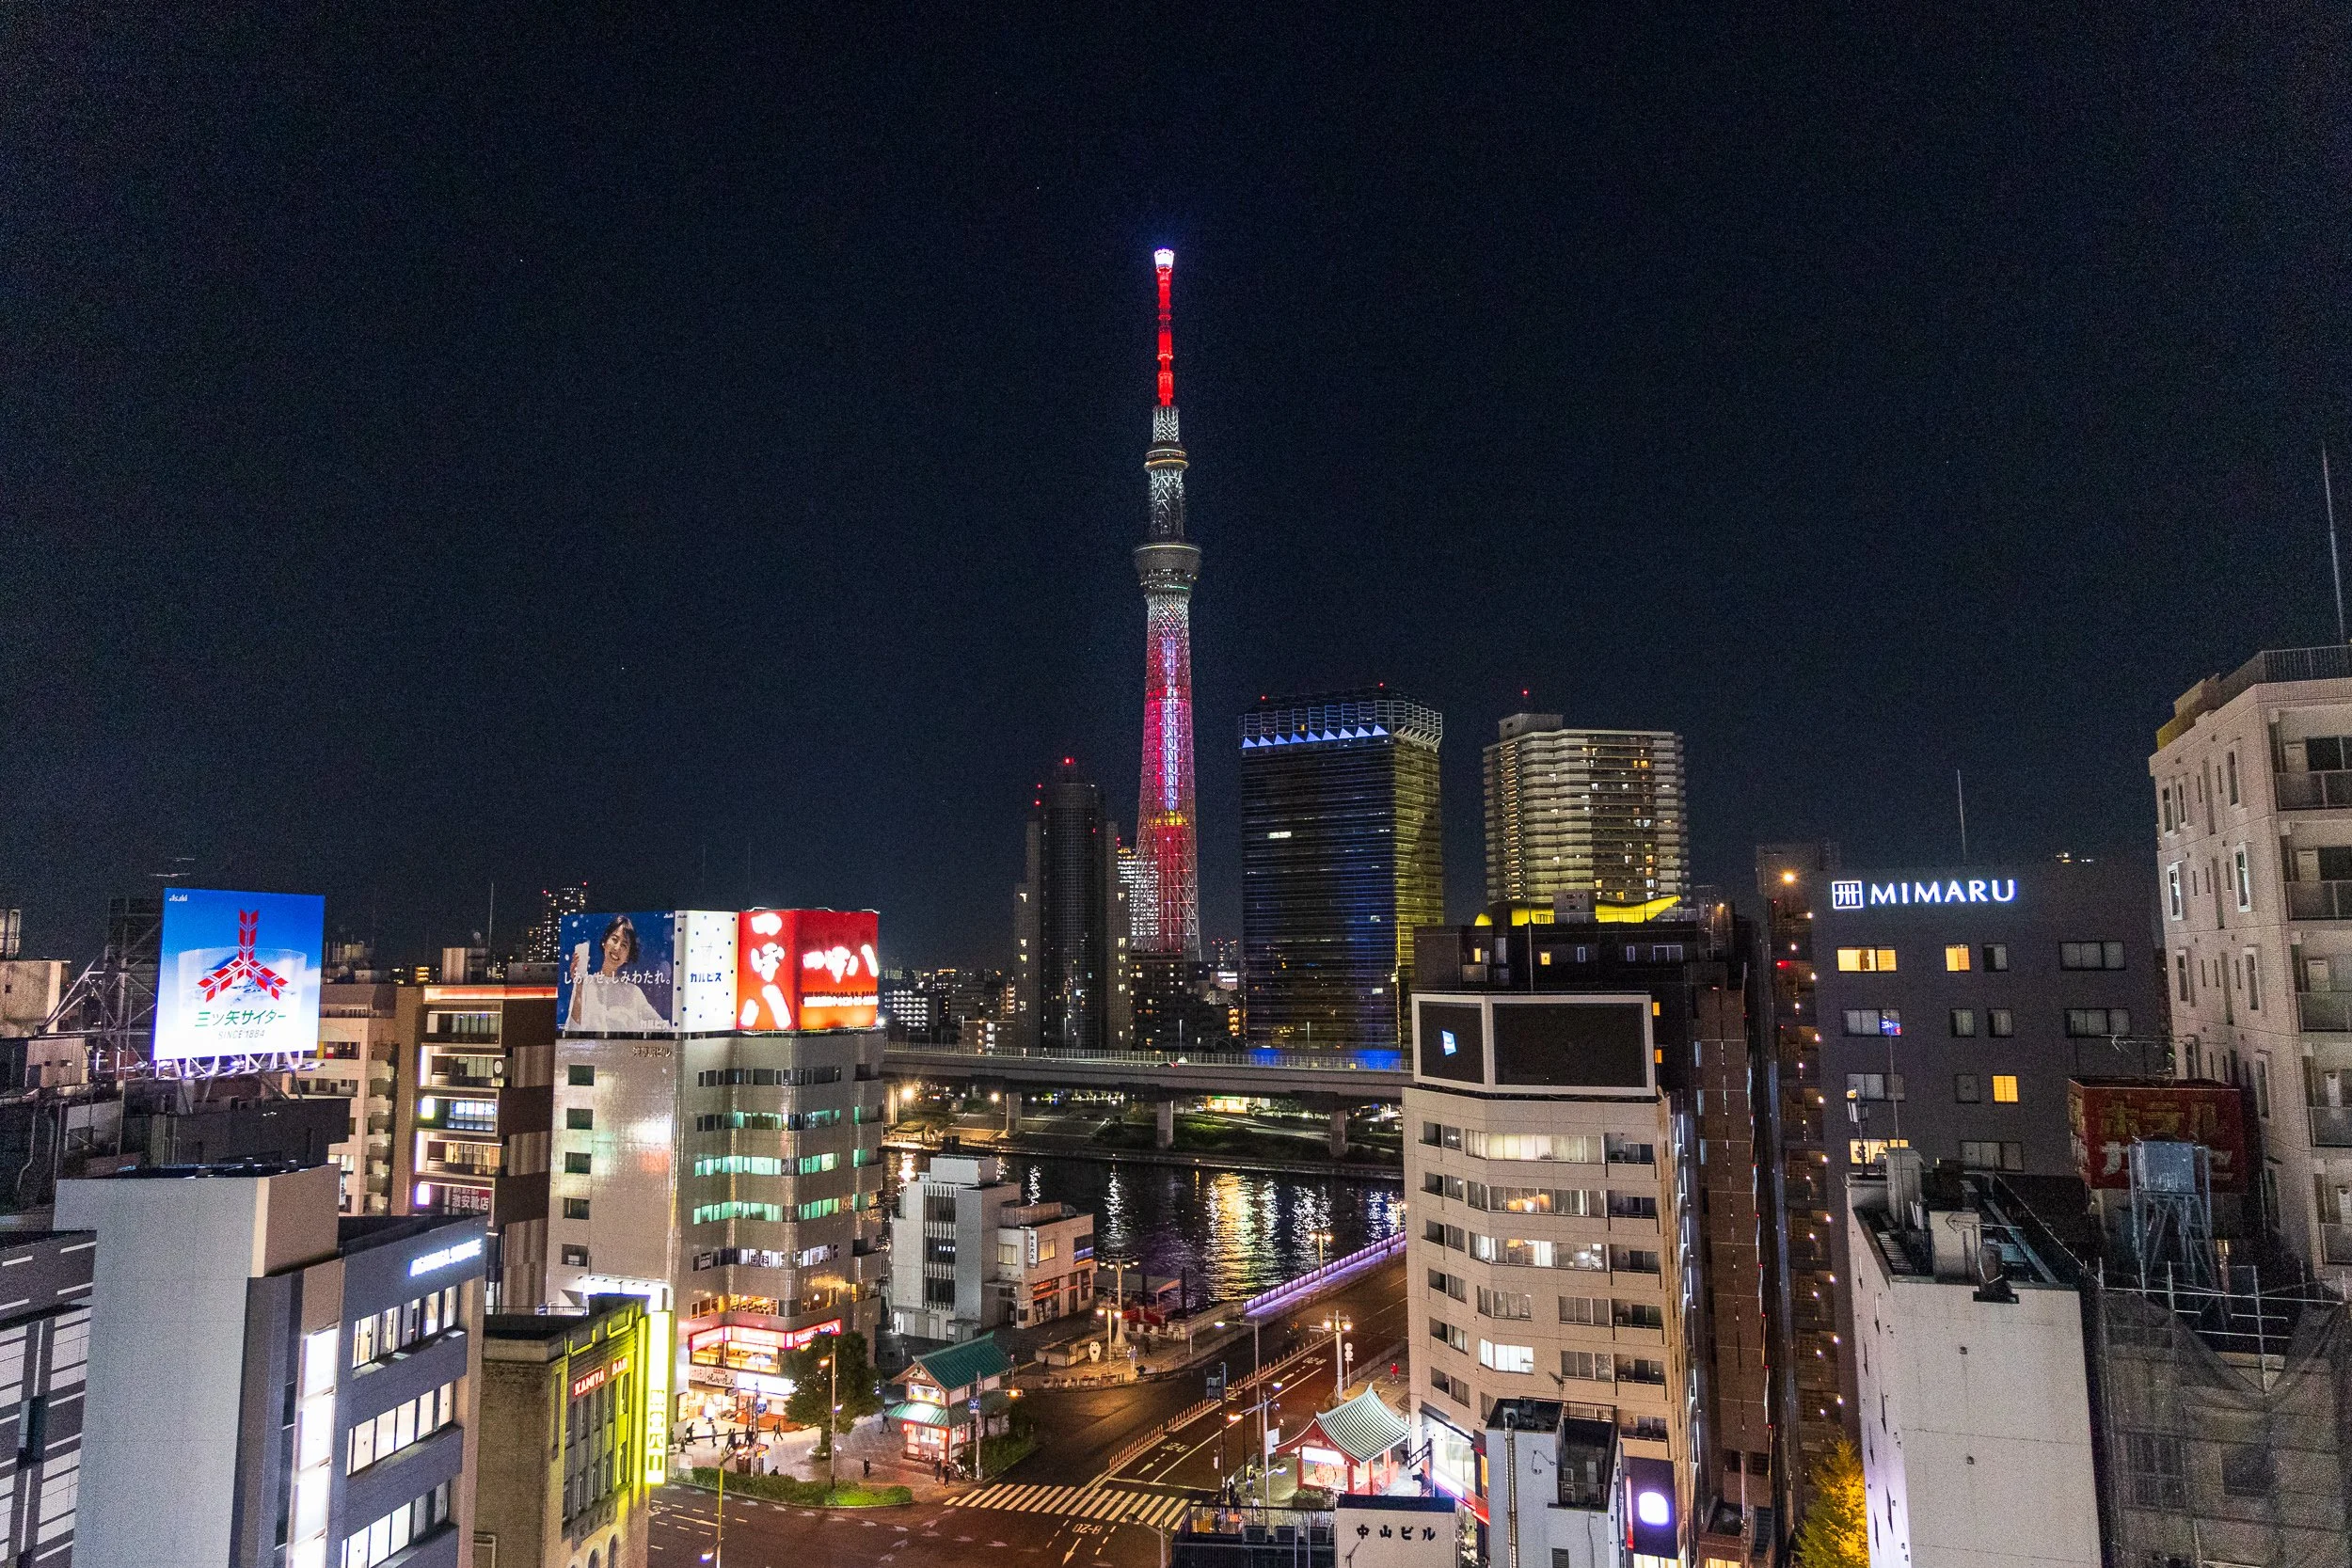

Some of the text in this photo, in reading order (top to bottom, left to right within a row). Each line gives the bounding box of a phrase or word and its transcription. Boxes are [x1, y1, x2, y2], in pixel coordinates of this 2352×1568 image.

[1869, 879, 2015, 905] MIMARU
[690, 972, 722, 983] カルピス
[217, 1029, 265, 1039] SINCE 1884
[574, 1357, 628, 1397] KAMIYA BAR
[1072, 1523, 1103, 1535] 8-20
[1356, 1523, 1437, 1541] 中山ビル
